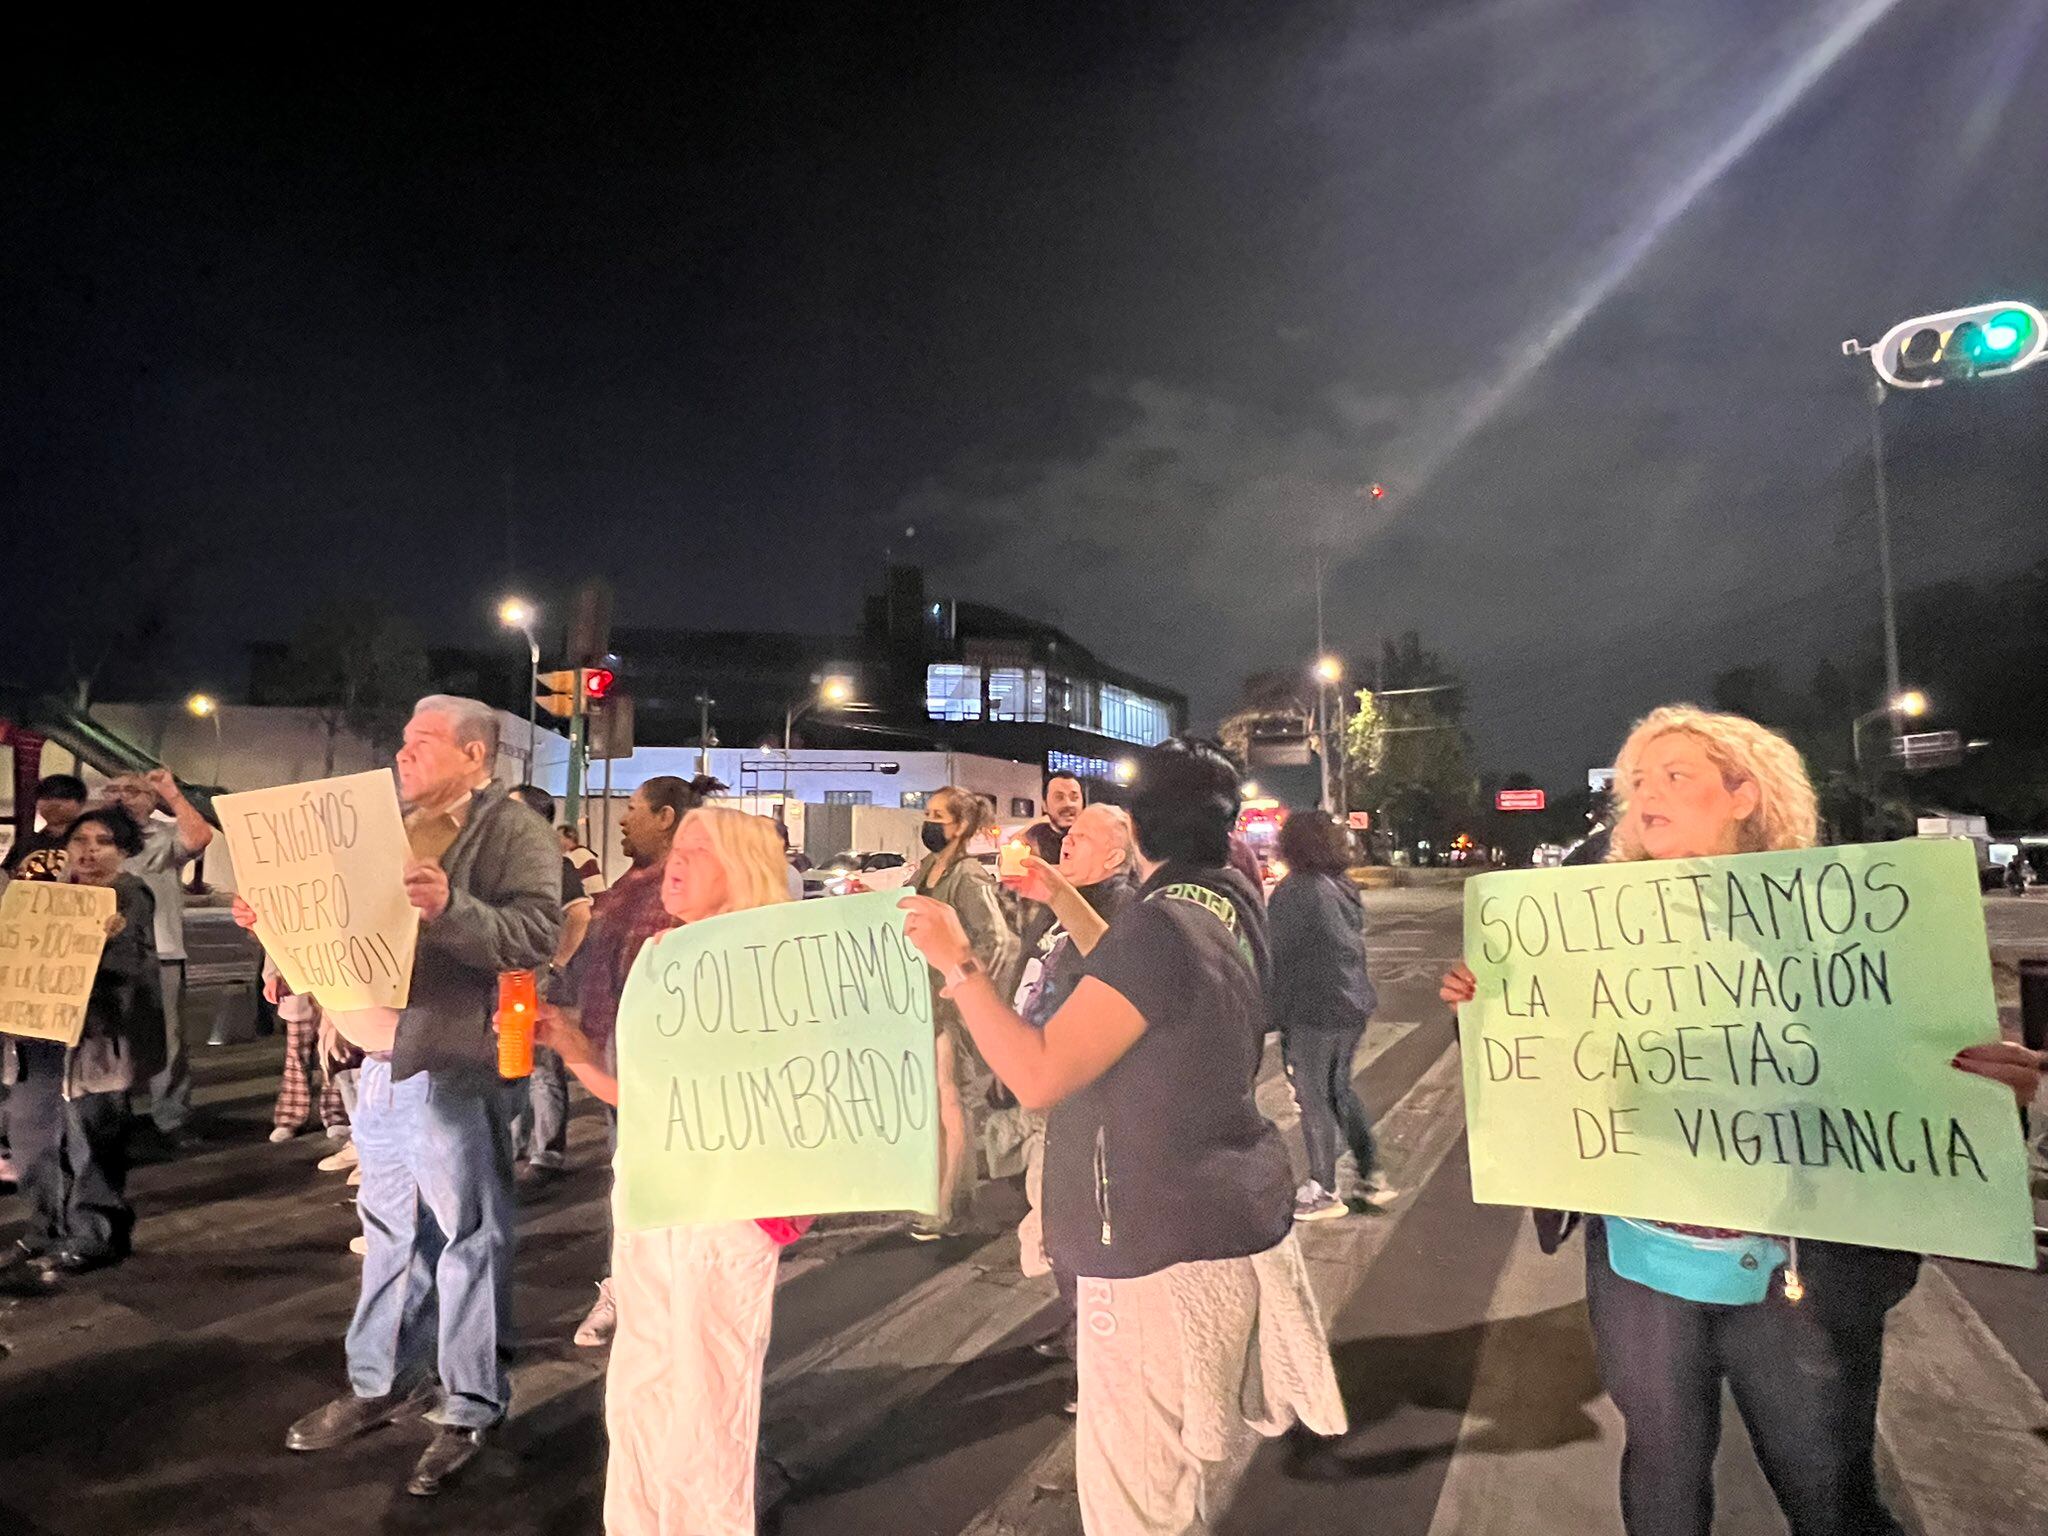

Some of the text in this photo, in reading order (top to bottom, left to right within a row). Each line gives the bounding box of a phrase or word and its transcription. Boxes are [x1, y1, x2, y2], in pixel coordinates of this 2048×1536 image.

[1480, 862, 1910, 965] SOLICITAMOS
[656, 922, 929, 1037] SOLICITAMOS
[1502, 974, 1550, 1018] LA
[1485, 1022, 1821, 1087] DE CASETAS
[664, 1047, 929, 1152] ALUMBRADO
[1573, 1107, 1989, 1183] DE VIGILANCIA
